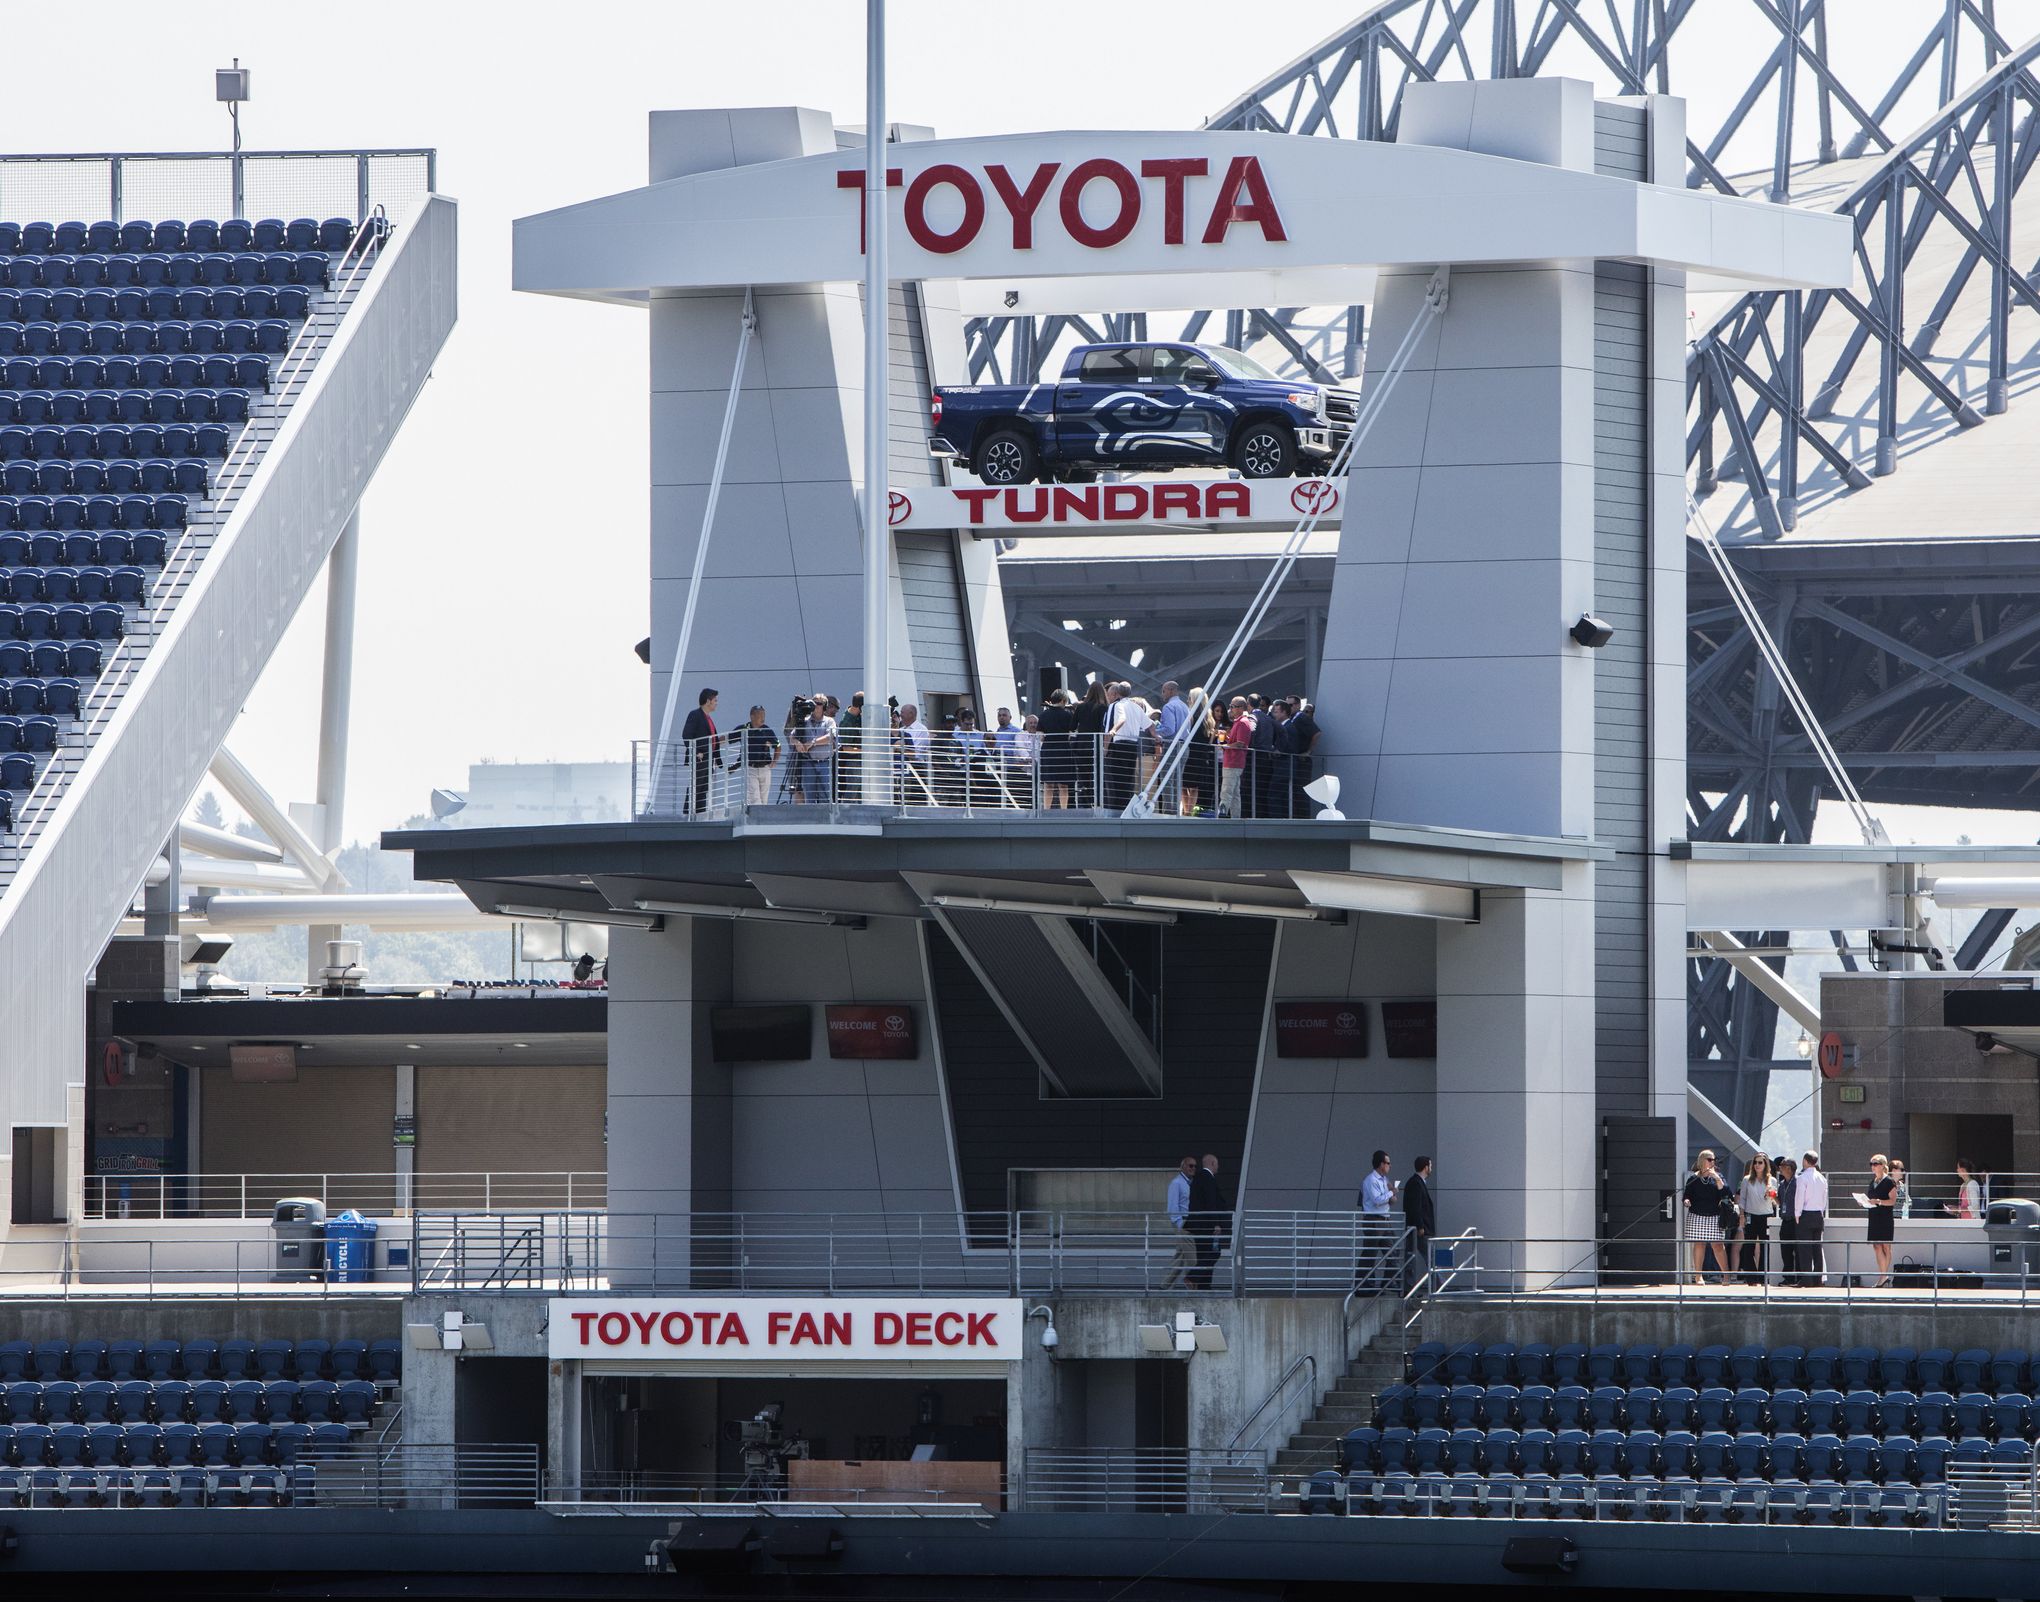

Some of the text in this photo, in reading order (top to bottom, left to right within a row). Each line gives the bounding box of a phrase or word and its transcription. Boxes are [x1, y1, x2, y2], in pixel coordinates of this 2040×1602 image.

[838, 155, 1288, 255] TOYOTA
[952, 483, 1252, 525] TUNDRA
[830, 1021, 877, 1030] WELCOME
[1278, 1018, 1329, 1029] WELCOME
[1825, 1045, 1839, 1066] W
[136, 1157, 160, 1170] GRILL
[572, 1312, 998, 1347] TOYOTA FAN DECK
